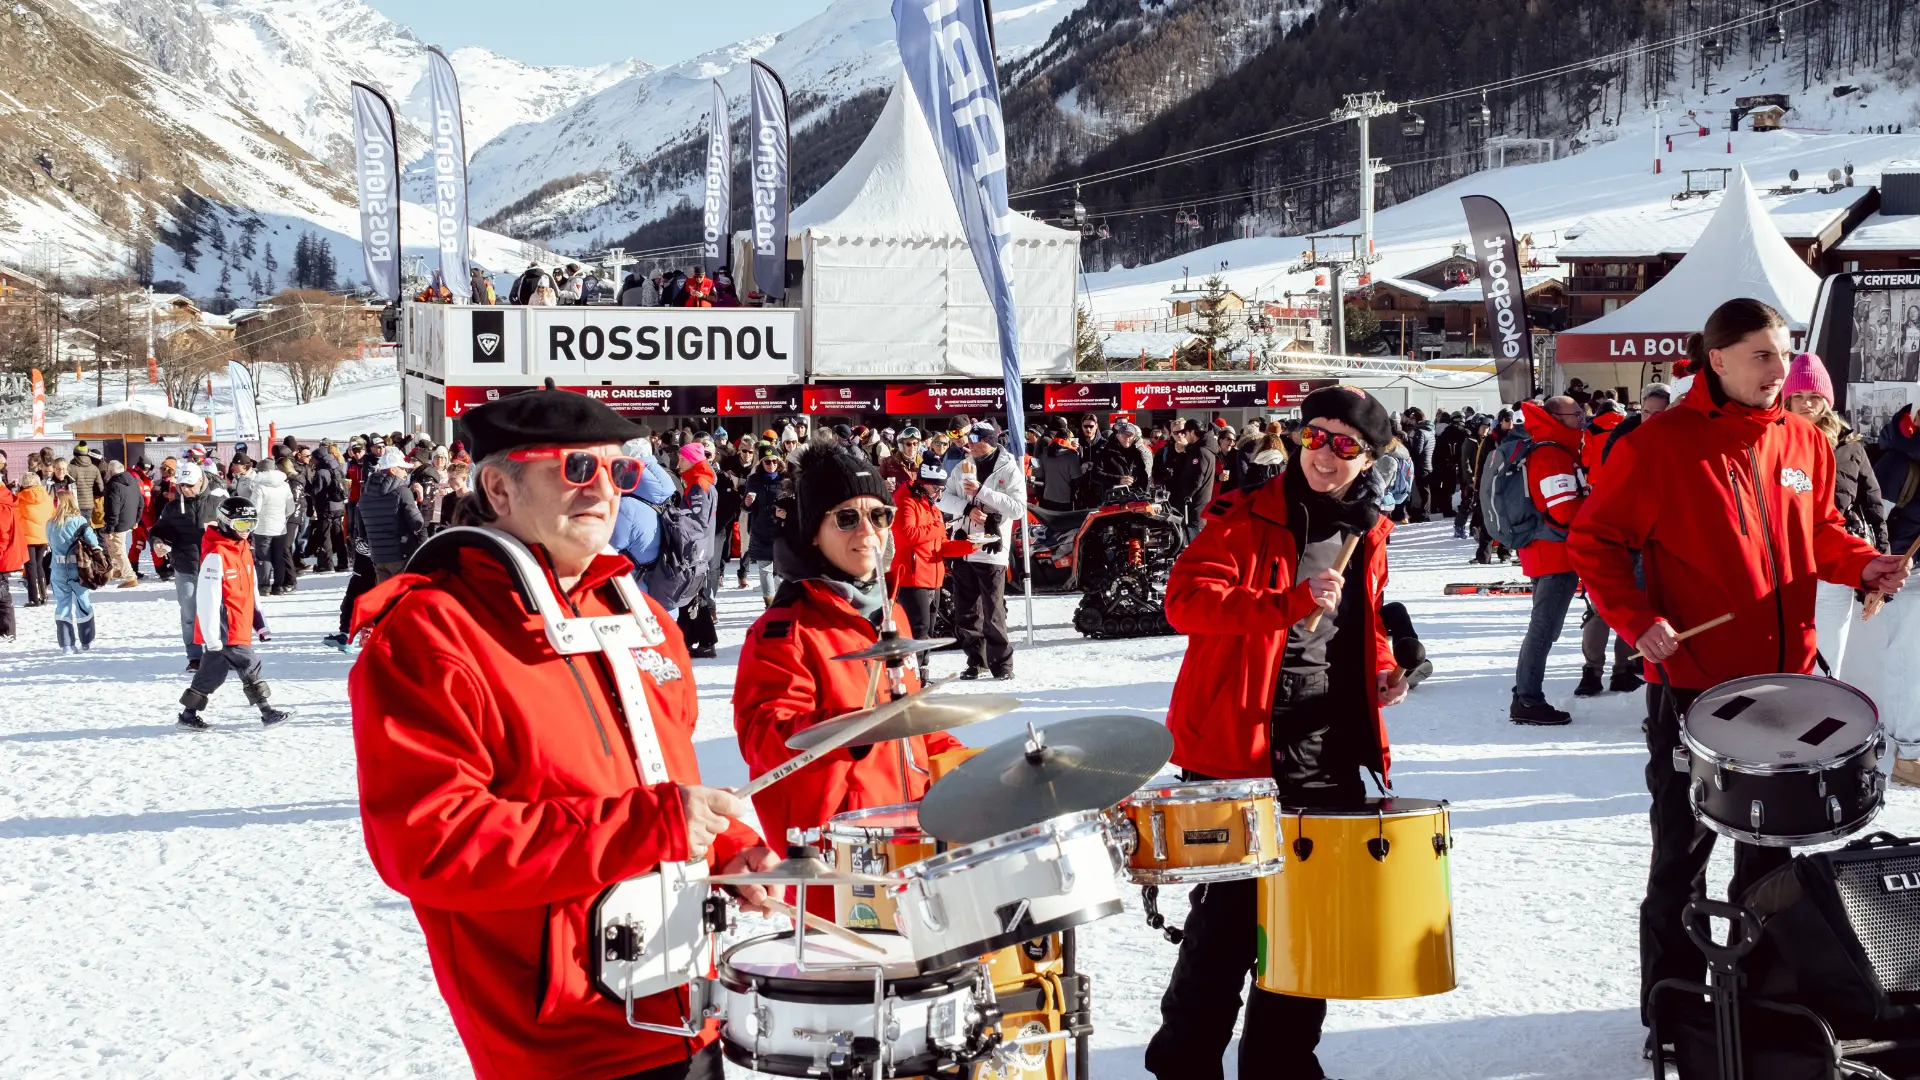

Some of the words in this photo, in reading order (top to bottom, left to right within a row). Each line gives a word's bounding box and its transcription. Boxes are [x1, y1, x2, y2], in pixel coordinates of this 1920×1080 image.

[549, 325, 788, 361] ROSSIGNOL
[1610, 339, 1636, 356] LA
[1644, 338, 1689, 356] BOU
[1651, 361, 1663, 383] ort
[586, 389, 608, 399] BAR
[611, 389, 673, 399] CARLSBERG
[928, 388, 948, 397] BAR
[950, 387, 1005, 397] CARLSBERG
[1134, 384, 1171, 395] HUÎTRES
[1177, 385, 1208, 394] SNACK
[1215, 384, 1257, 393] RACLETTE
[1884, 872, 1920, 891] CU
